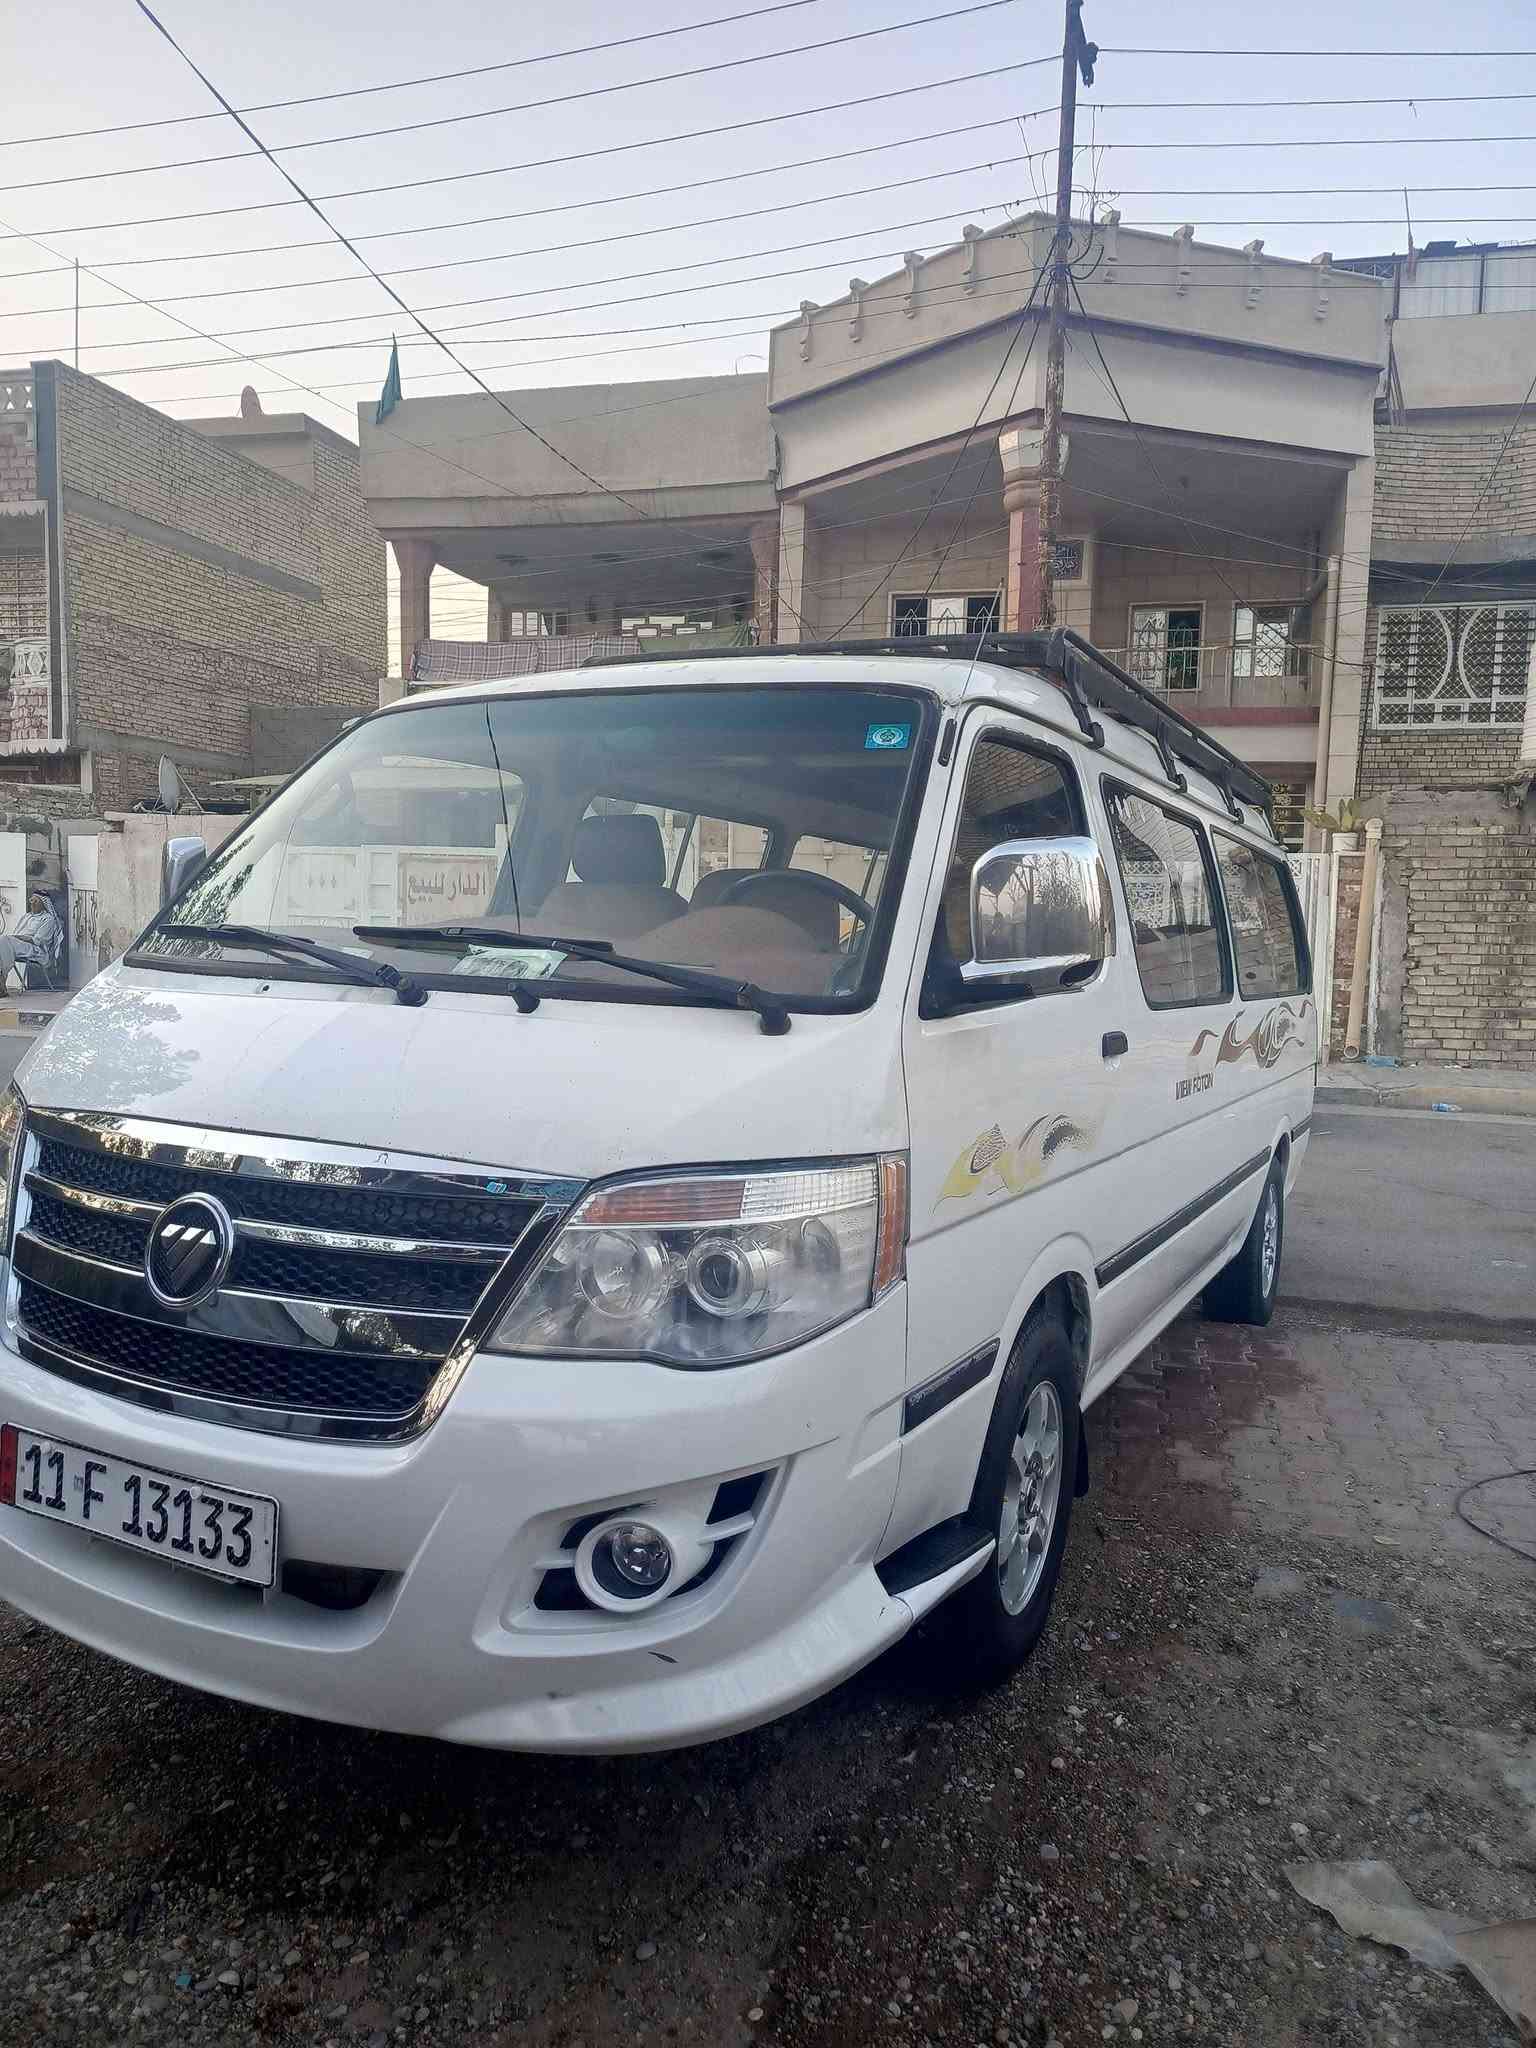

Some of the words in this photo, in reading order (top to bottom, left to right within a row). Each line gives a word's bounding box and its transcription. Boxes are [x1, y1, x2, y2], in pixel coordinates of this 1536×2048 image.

[407, 872, 445, 904] للبيع
[447, 872, 486, 901] الدار
[1193, 1072, 1214, 1094] FOTON
[23, 1444, 66, 1510] 11
[83, 1461, 107, 1519] F
[122, 1474, 254, 1567] 13133
